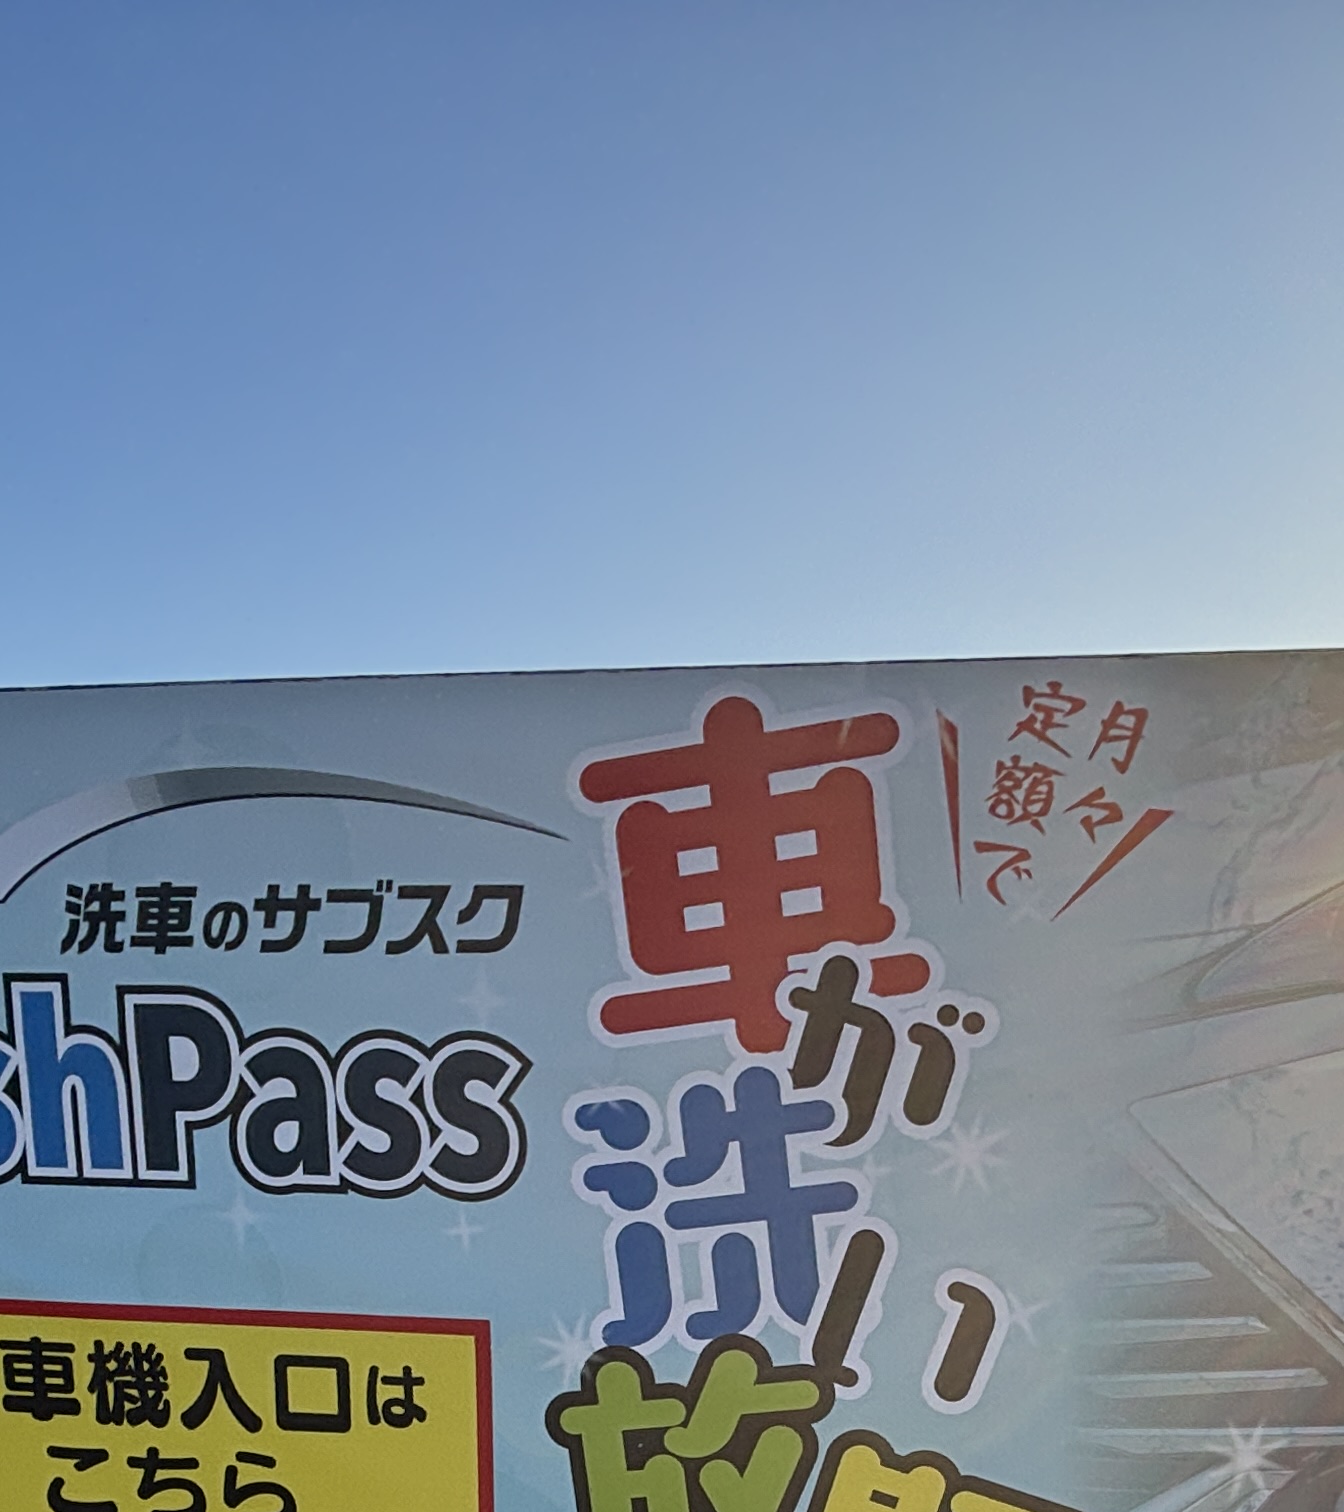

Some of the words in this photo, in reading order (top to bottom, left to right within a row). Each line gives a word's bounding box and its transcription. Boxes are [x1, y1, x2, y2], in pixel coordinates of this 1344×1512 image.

[973, 680, 1088, 907] 定額で
[1062, 700, 1150, 845] 月々
[59, 880, 525, 955] 洗車のサブスク
